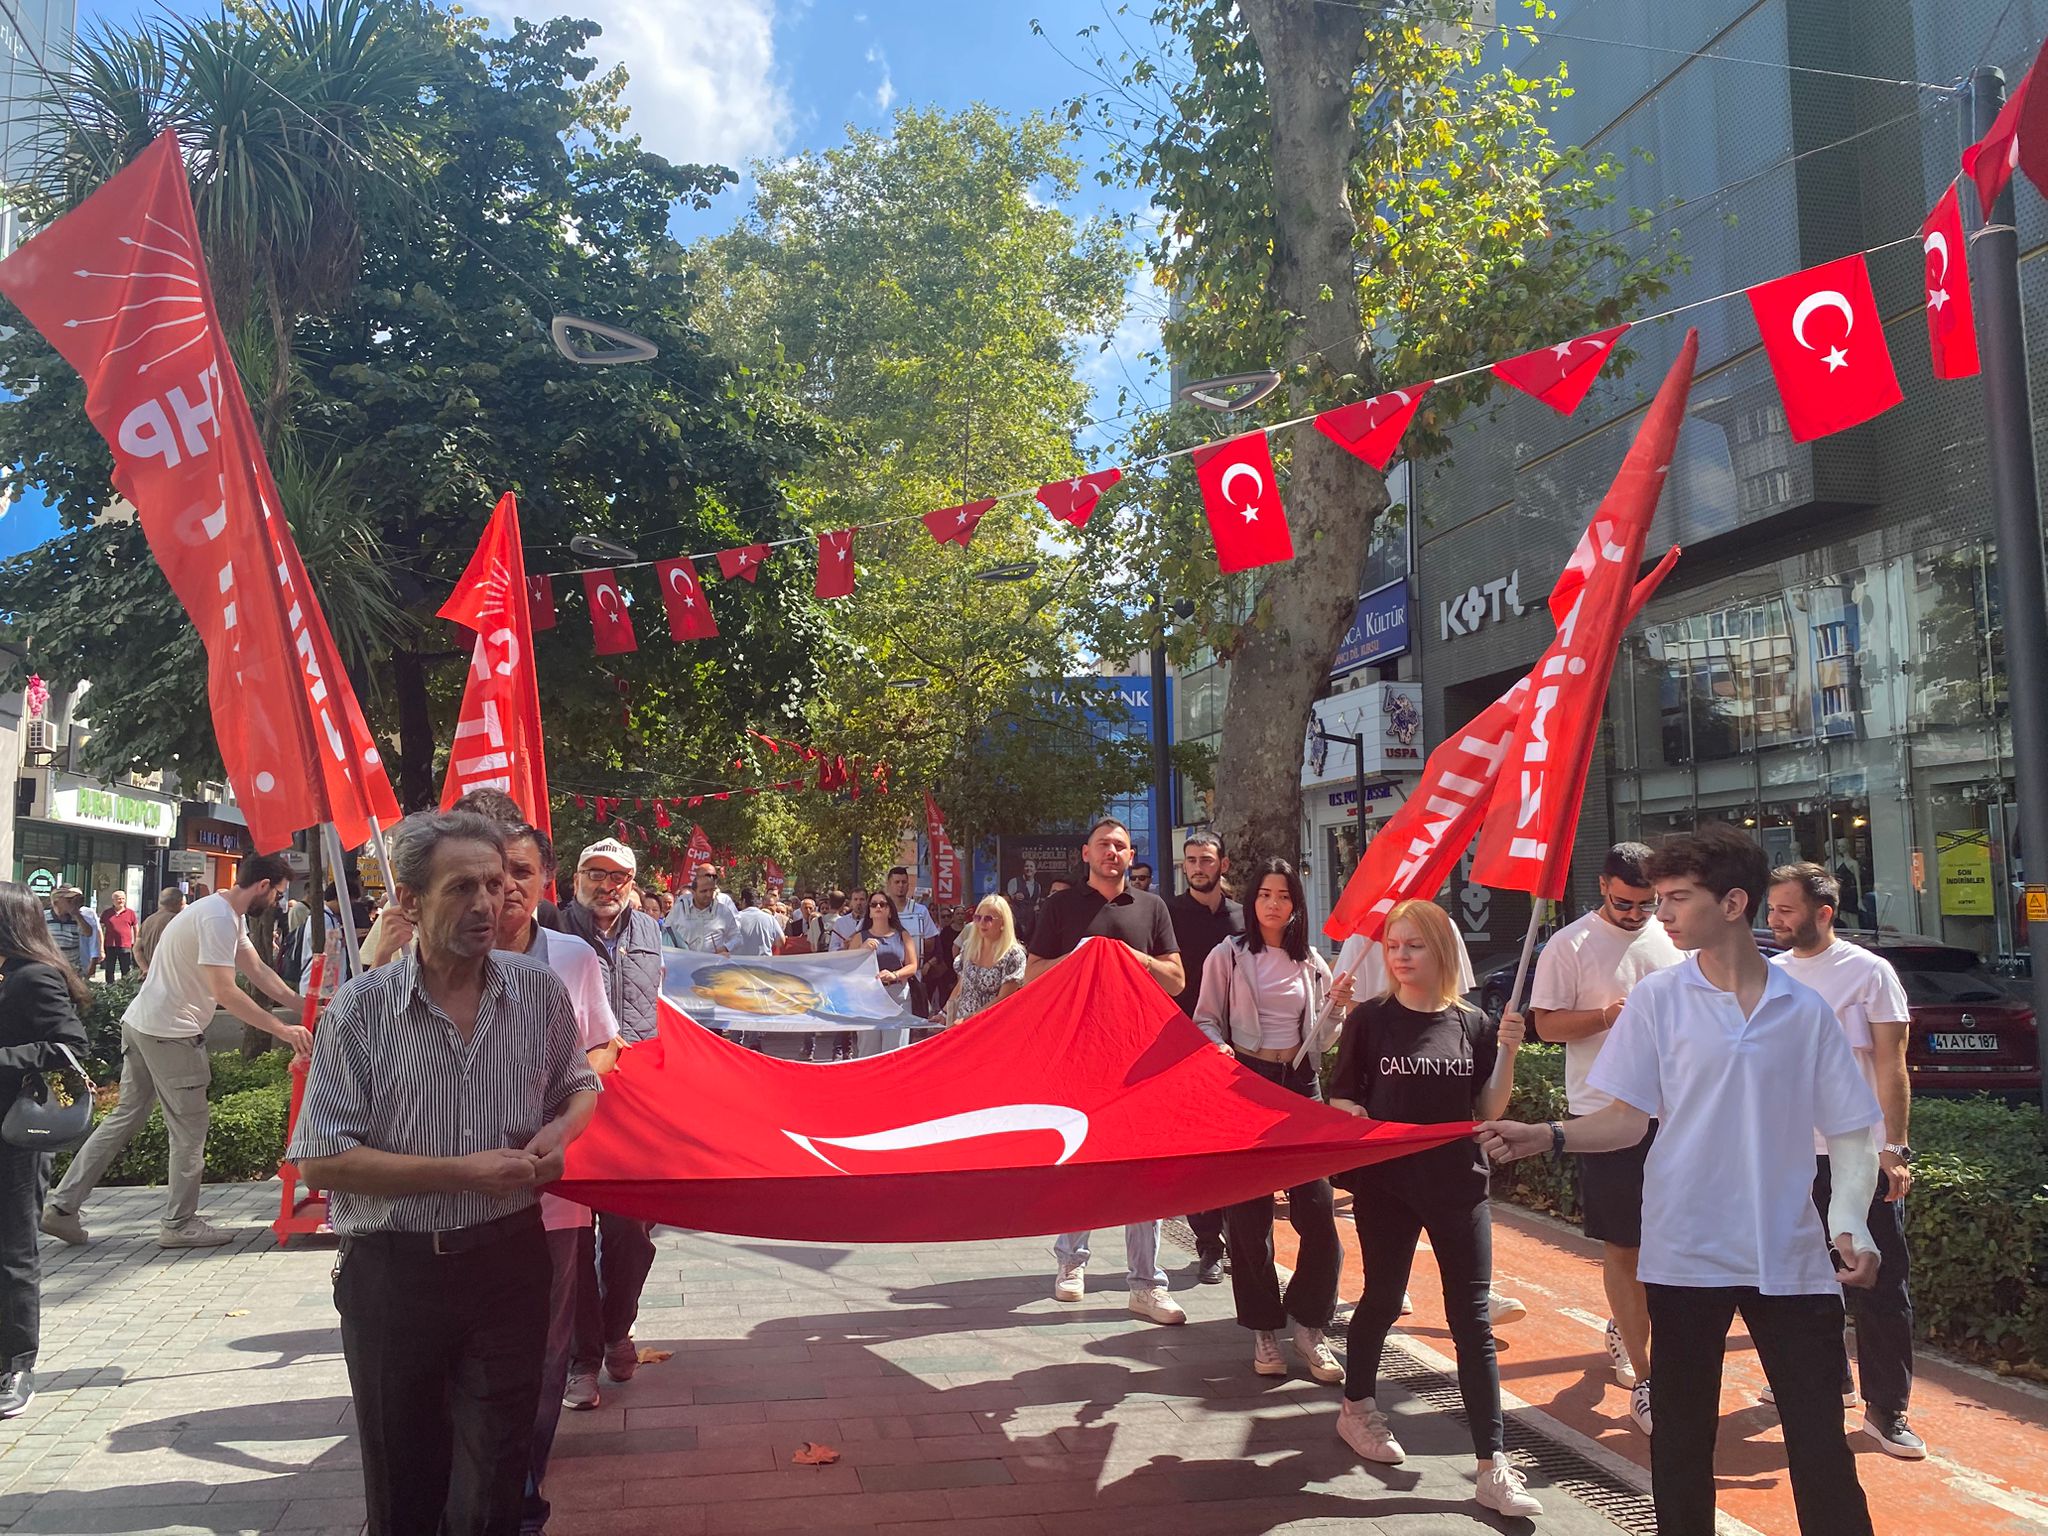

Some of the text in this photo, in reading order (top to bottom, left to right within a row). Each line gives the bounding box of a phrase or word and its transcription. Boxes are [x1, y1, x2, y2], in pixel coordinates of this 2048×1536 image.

[1365, 604, 1405, 638] KÜLTÜR
[1385, 748, 1419, 758] USPA
[688, 847, 711, 860] CHP
[768, 876, 784, 885] CHP
[1936, 1035, 1948, 1048] 41
[1950, 1035, 1976, 1048] AYC
[1380, 1056, 1440, 1075] CALVIN
